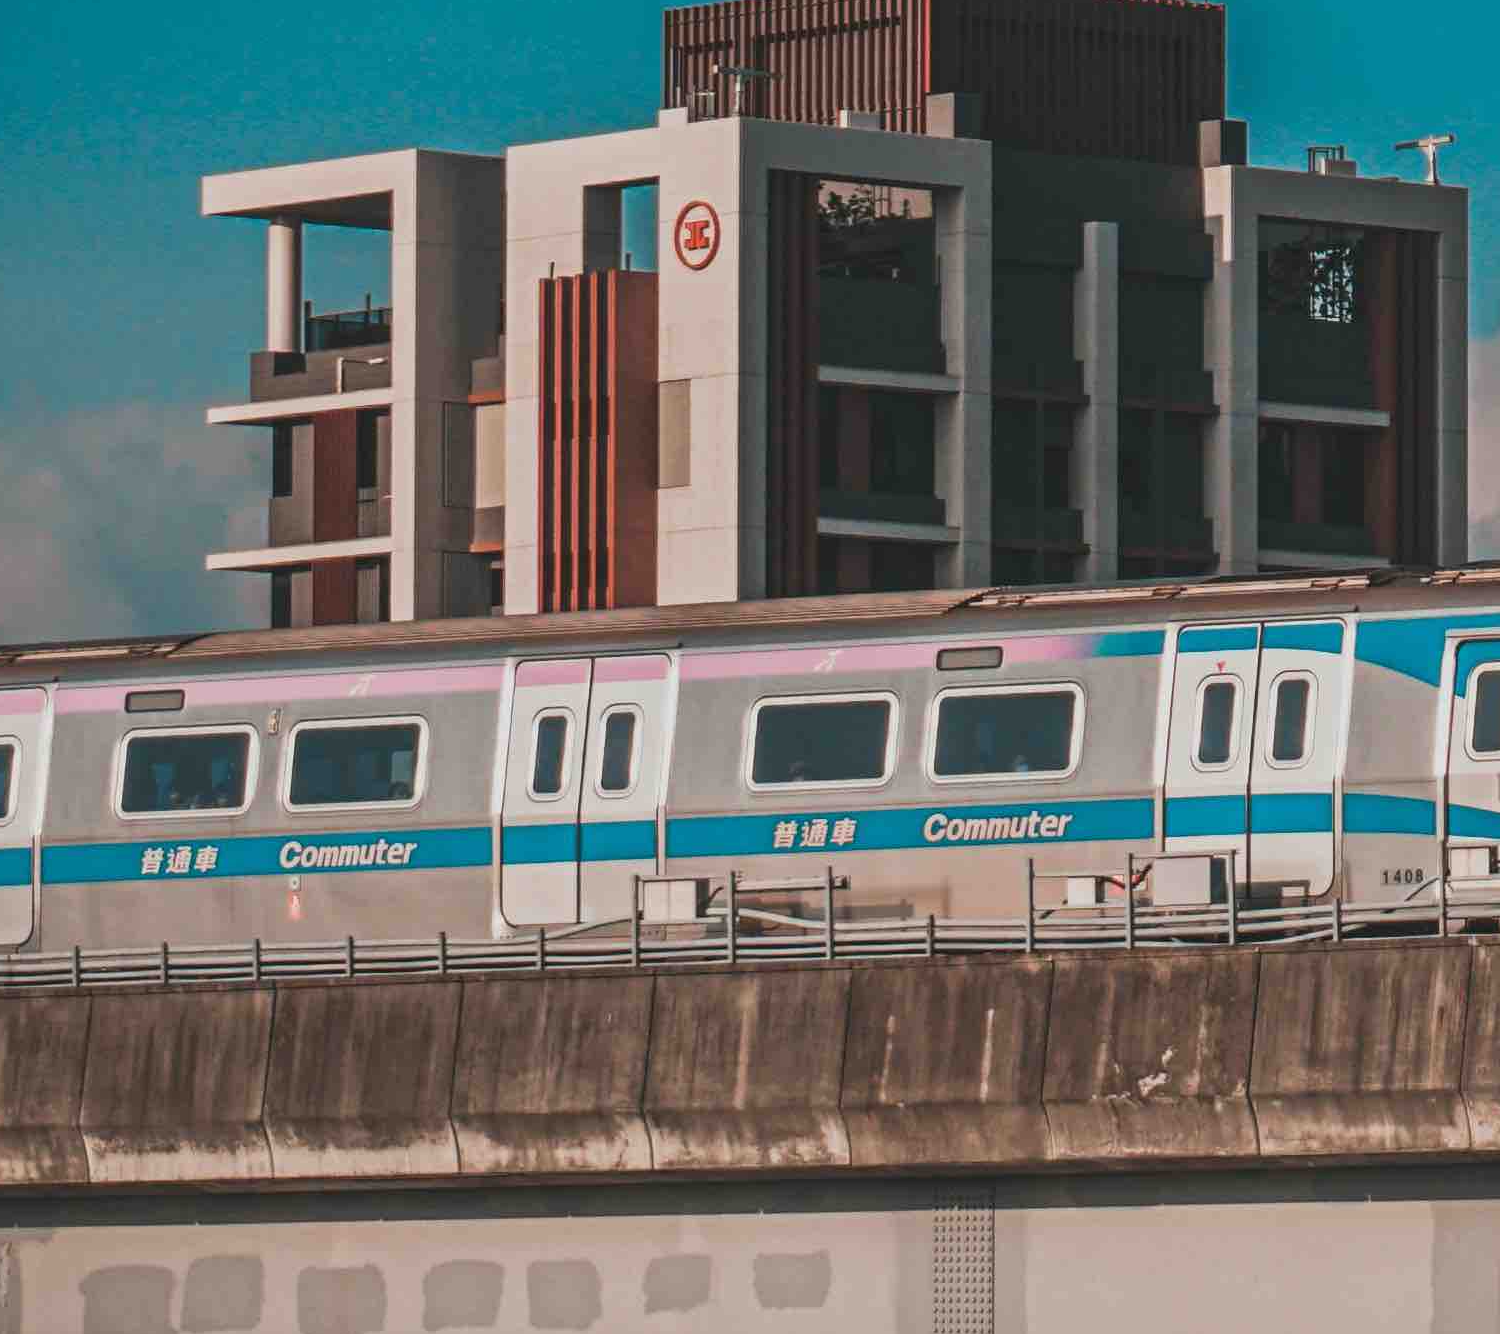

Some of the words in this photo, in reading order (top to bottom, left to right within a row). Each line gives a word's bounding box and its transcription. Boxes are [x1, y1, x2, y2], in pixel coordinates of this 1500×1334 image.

[772, 817, 856, 848] 普通車
[923, 811, 1073, 842] Commuter
[140, 846, 219, 875] 普通車
[279, 838, 418, 869] Commuter
[1383, 868, 1424, 884] 1408
